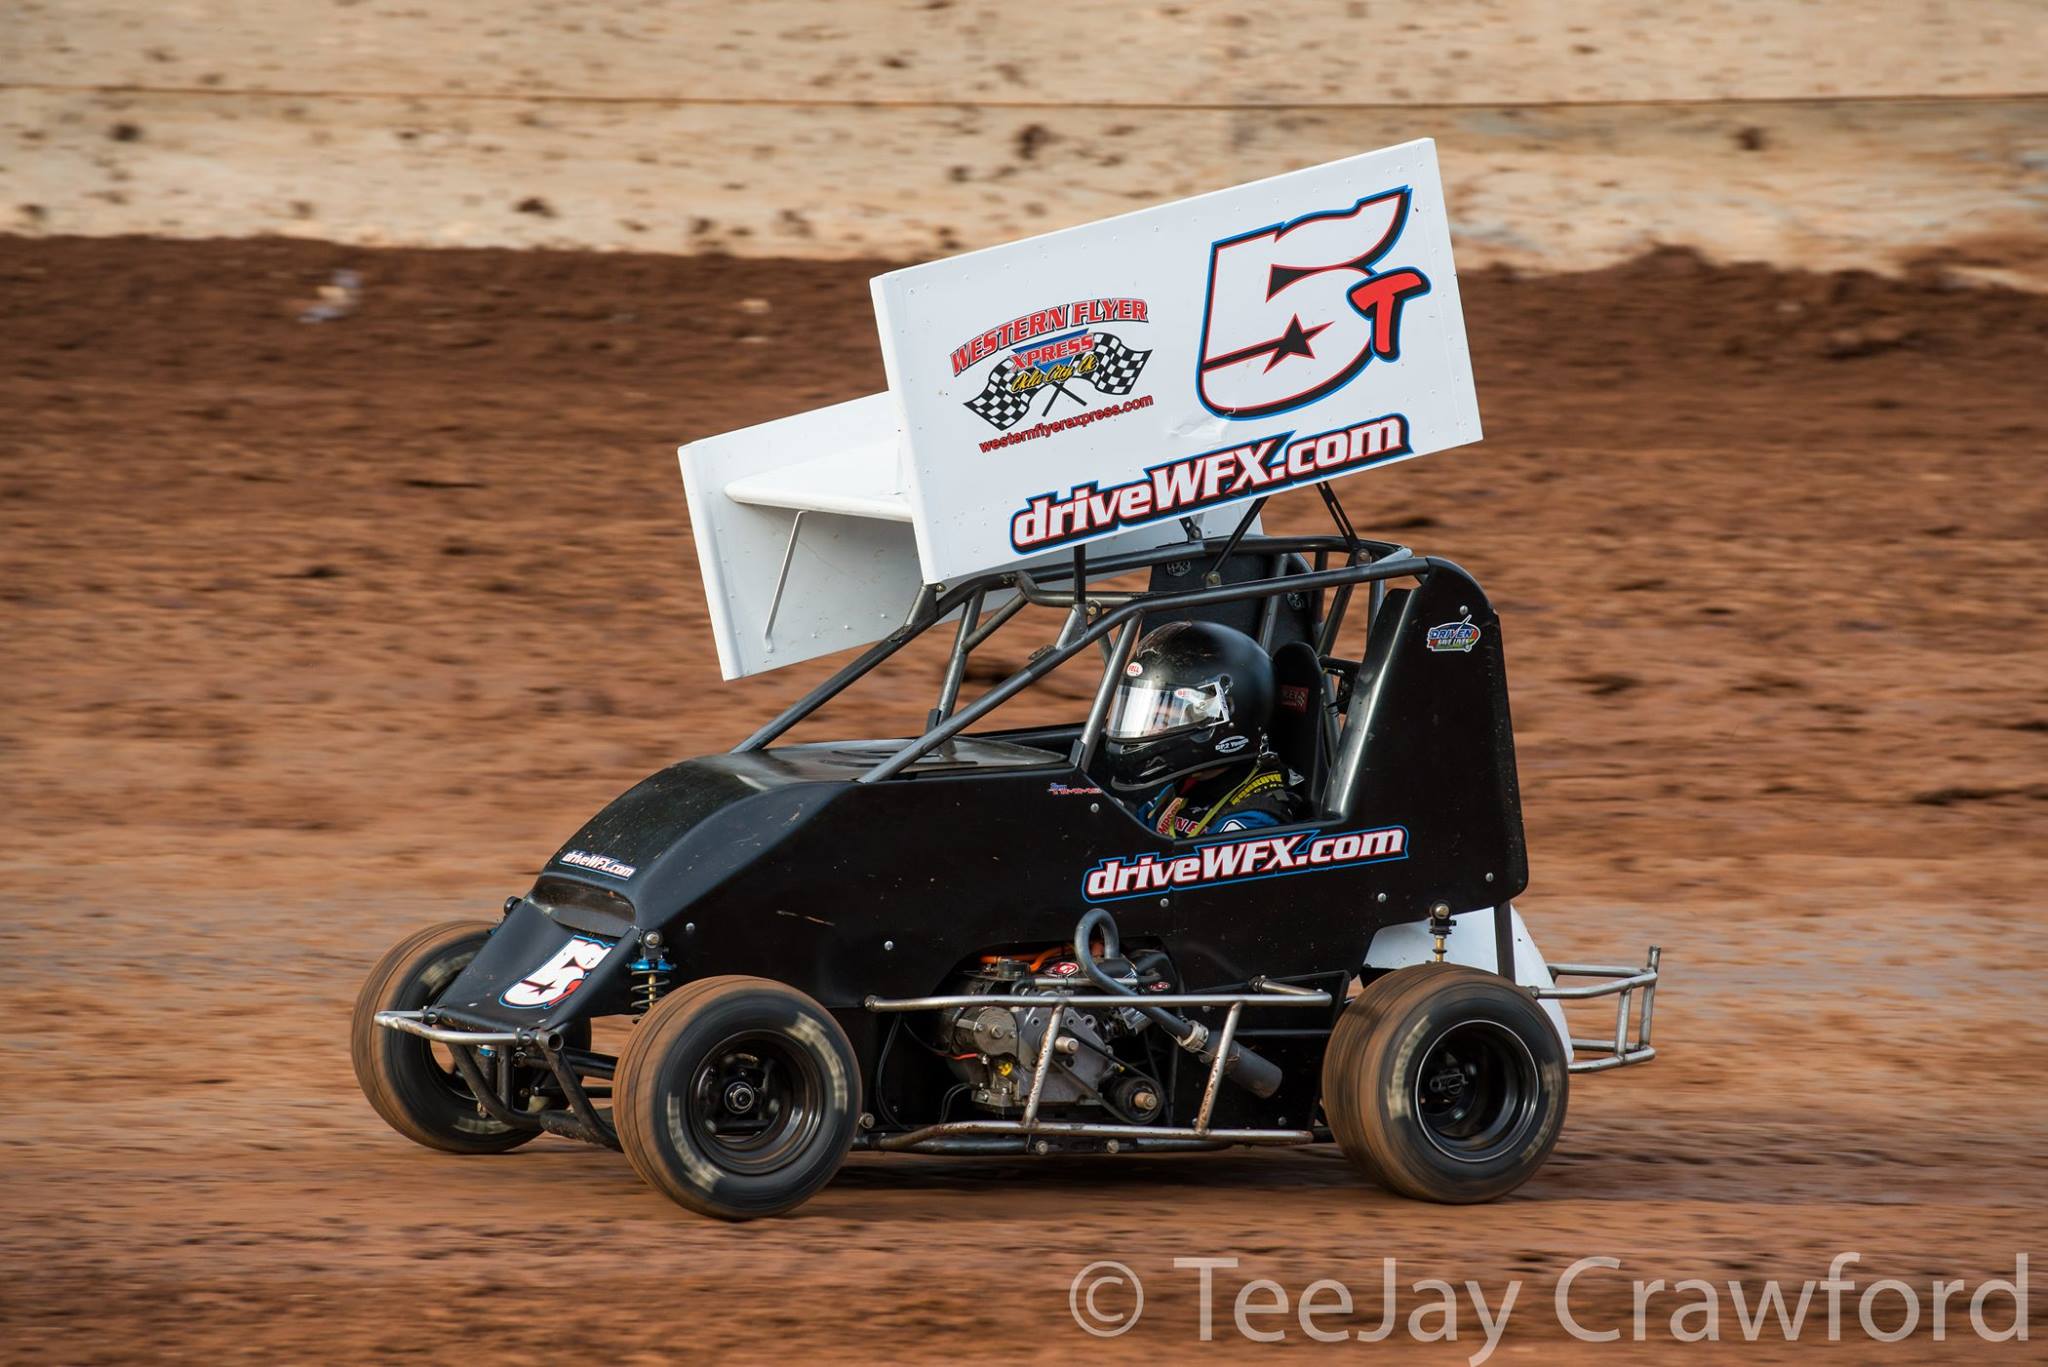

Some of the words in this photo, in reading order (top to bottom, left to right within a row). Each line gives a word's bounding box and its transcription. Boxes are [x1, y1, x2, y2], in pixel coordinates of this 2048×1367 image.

[950, 303, 1070, 377] WESTERN
[1070, 298, 1149, 326] FLYER
[1009, 334, 1095, 372] XPRESS
[978, 395, 1154, 453] westernflyerexpress.com
[1013, 416, 1402, 547] driveWFX.com
[1429, 628, 1471, 640] DRIVEN
[562, 851, 636, 878] driveWFX.com
[1087, 828, 1404, 895] driveWFX.com
